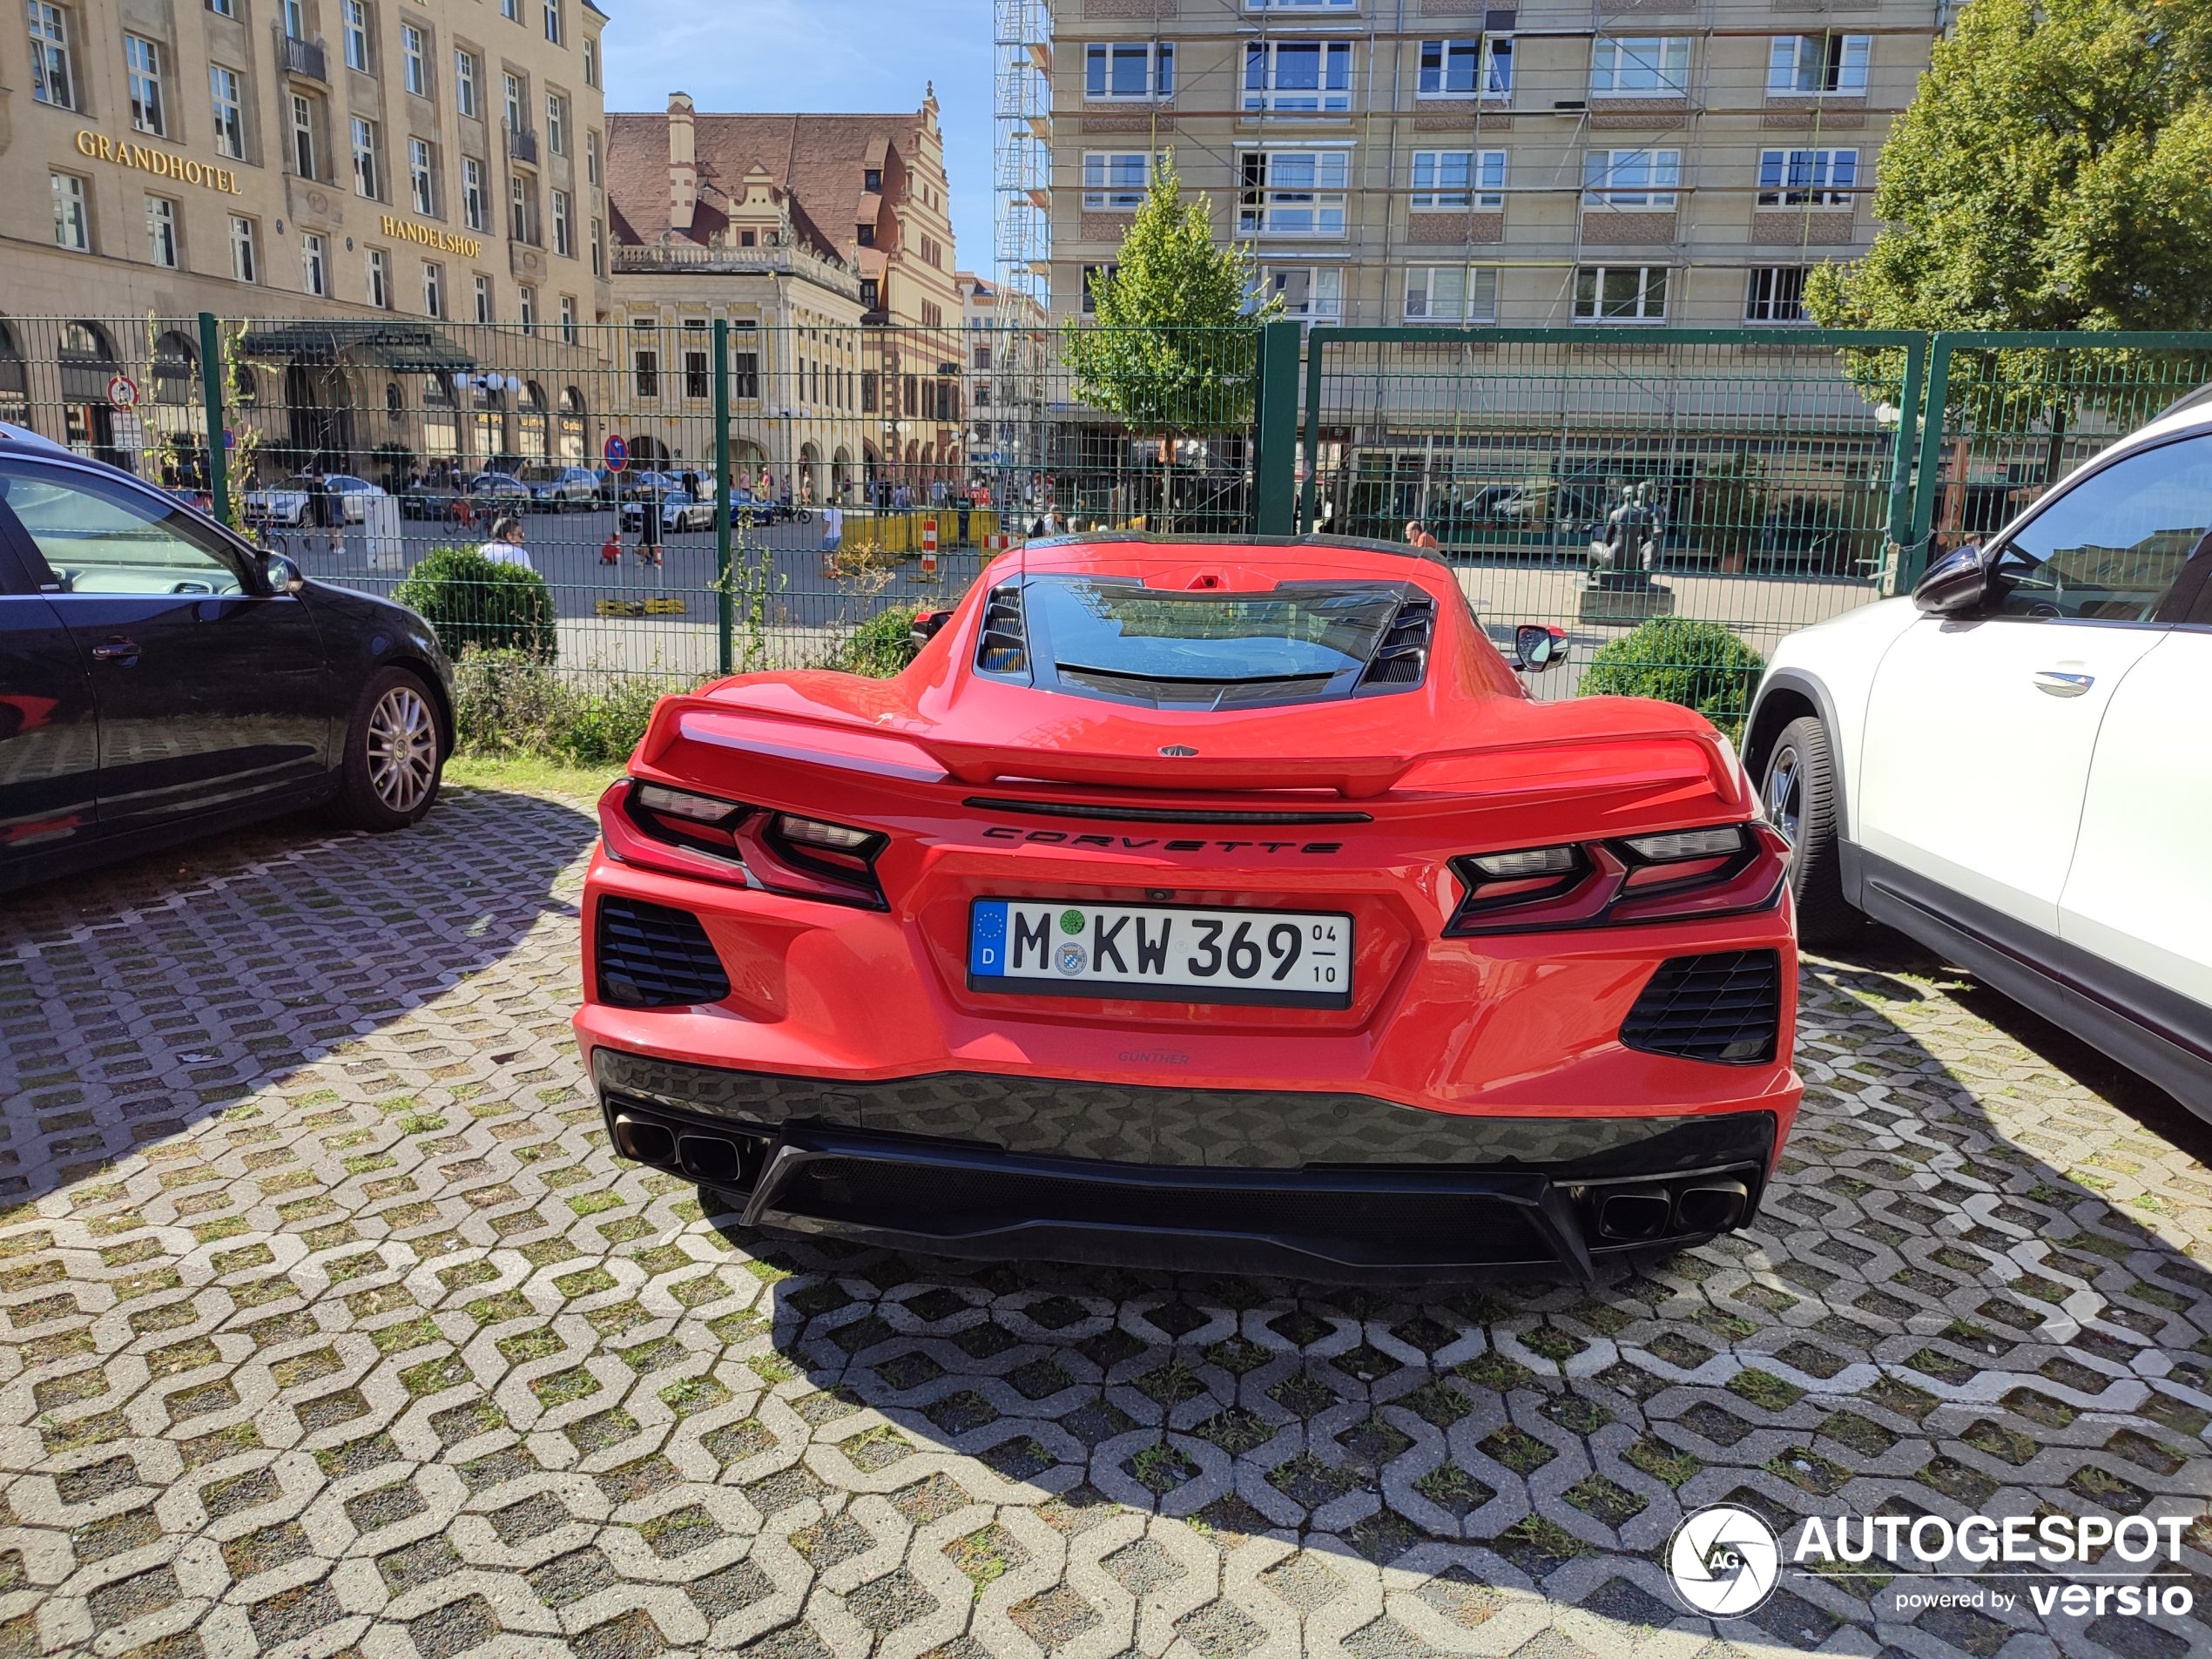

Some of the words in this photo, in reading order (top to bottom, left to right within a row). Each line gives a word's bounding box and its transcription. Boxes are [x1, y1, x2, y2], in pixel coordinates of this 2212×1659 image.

[75, 130, 243, 195] GRANDHOTEL
[381, 215, 482, 259] HANDELSHOF
[982, 826, 1344, 853] CORVETTE
[1013, 912, 1051, 969] M
[1093, 915, 1172, 975] KW
[1188, 919, 1303, 981] 369
[1312, 924, 1337, 942] 04
[981, 948, 995, 965] D
[1313, 966, 1336, 983] 10
